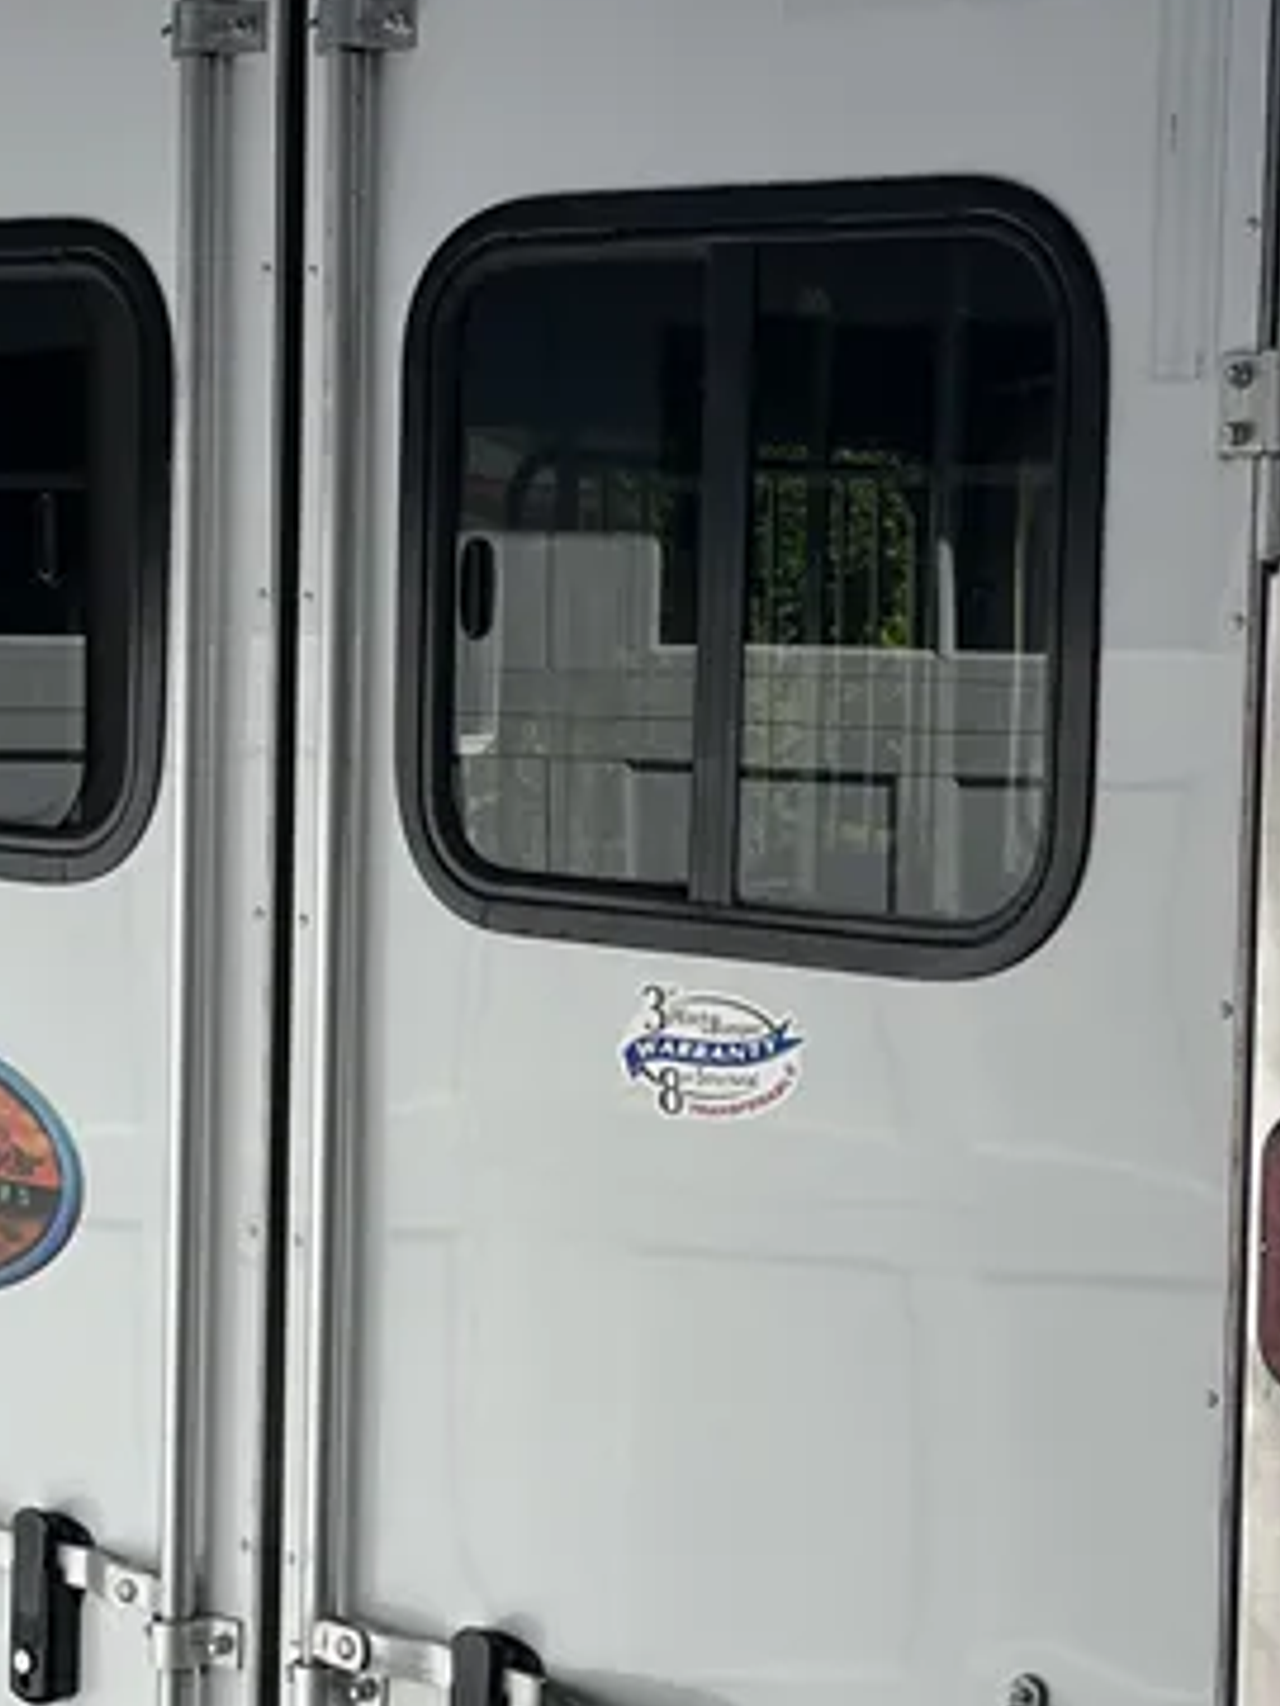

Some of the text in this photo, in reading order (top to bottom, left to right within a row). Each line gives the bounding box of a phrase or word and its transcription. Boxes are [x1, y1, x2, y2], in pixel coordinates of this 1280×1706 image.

[642, 984, 666, 1030] 3
[639, 1038, 775, 1062] WARRANTY
[658, 1066, 684, 1115] 8
